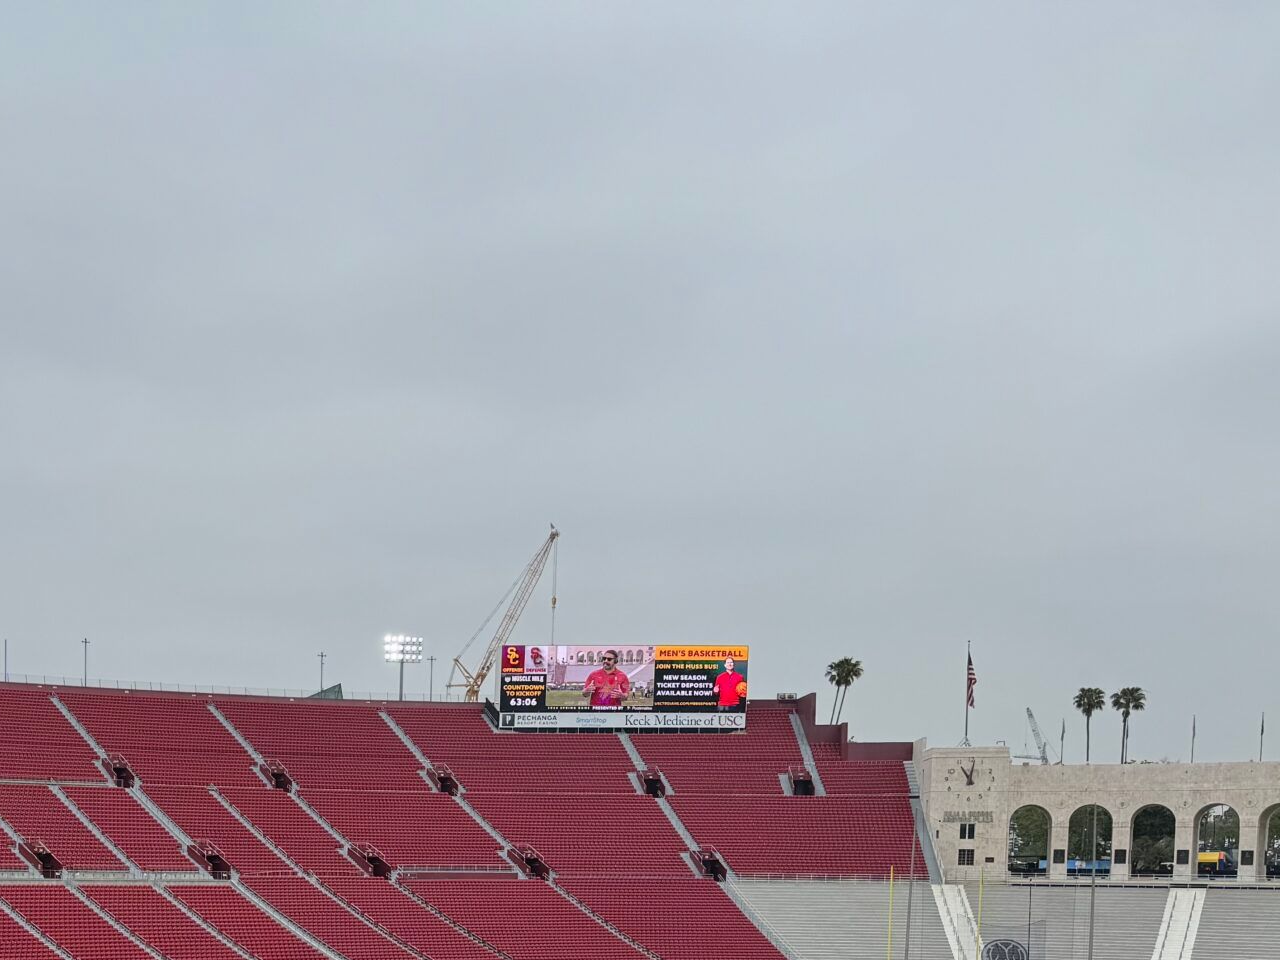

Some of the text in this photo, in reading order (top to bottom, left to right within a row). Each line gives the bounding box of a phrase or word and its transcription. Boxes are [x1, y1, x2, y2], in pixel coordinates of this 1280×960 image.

[510, 698, 537, 706] 63:06
[625, 714, 743, 726] Keck Medicine of USC
